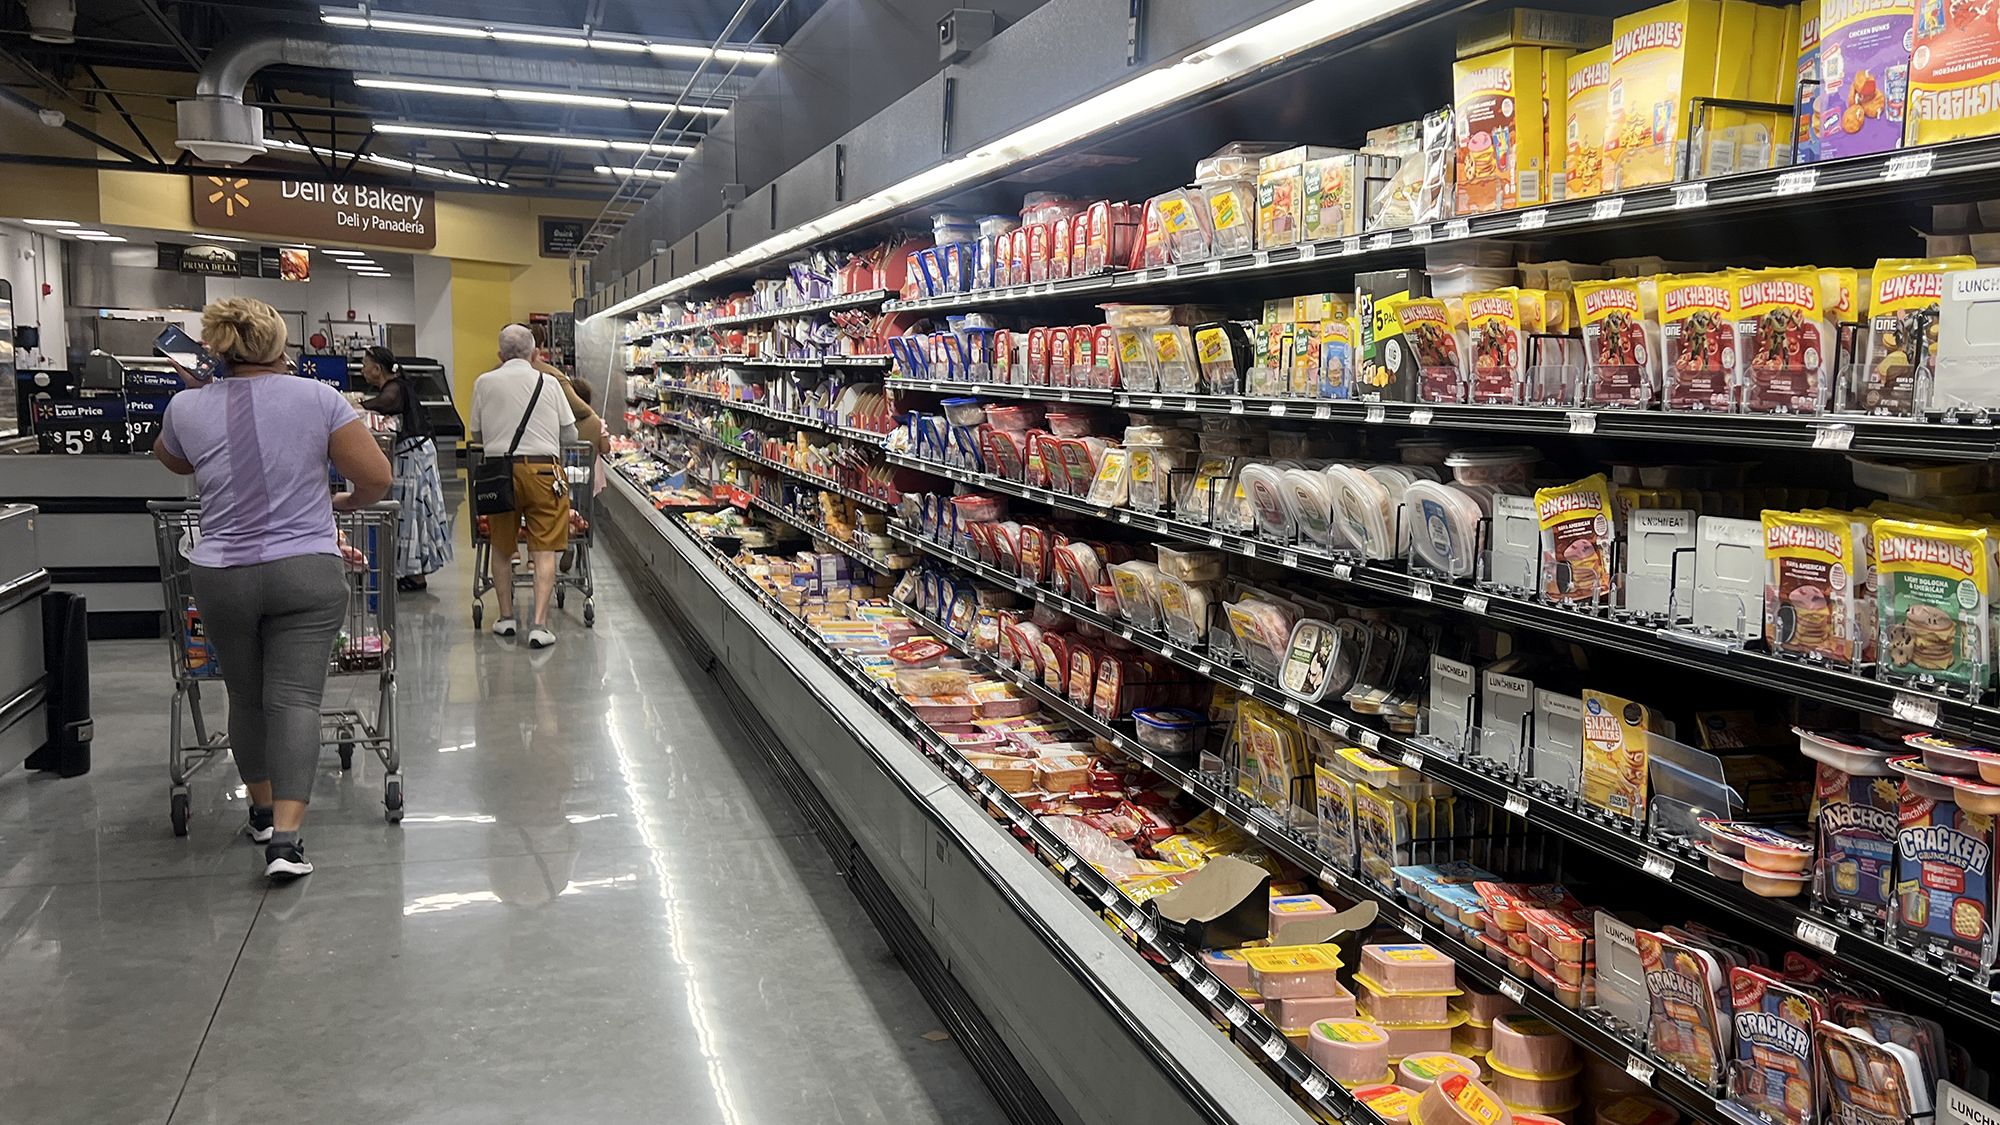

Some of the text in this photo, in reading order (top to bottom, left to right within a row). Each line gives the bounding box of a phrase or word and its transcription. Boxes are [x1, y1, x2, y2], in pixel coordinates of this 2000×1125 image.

[1612, 21, 1683, 65] LUNCHABLES
[1849, 29, 1870, 39] CHICKEN
[1567, 61, 1609, 100] LUNCHAB
[354, 184, 424, 220] Bakery
[337, 211, 425, 235] Deli y Panadería
[183, 262, 210, 272] PRIMA
[211, 262, 238, 273] DELLA
[1739, 280, 1814, 310] LUNCHABLES
[1880, 273, 1943, 303] LUNCHAB
[1958, 279, 2000, 293] LUNCH
[1469, 297, 1514, 320] LUNCHABLES
[1584, 289, 1637, 315] LUNCHABLES
[1664, 286, 1731, 312] LUNCHABLES
[1375, 310, 1384, 331] 5
[1400, 304, 1447, 326] LUNCHABLES
[1876, 319, 1897, 331] ONE
[55, 407, 103, 417] Low Price
[131, 402, 154, 410] Price
[1540, 491, 1602, 521] LUNCHABLES
[1767, 526, 1842, 560] LUNCHABLES
[1879, 537, 1974, 575] LUNCHABLES
[1919, 578, 1948, 588] BOLOGNA
[1436, 661, 1468, 678] LUNCHMEAT
[1585, 716, 1618, 730] SNACK
[1587, 729, 1620, 741] BUILDERS
[1900, 827, 1987, 872] CRACKER
[1604, 924, 1636, 945] LUNCHM
[1647, 972, 1704, 1006] CRACKER
[1736, 1014, 1808, 1056] CRACKER
